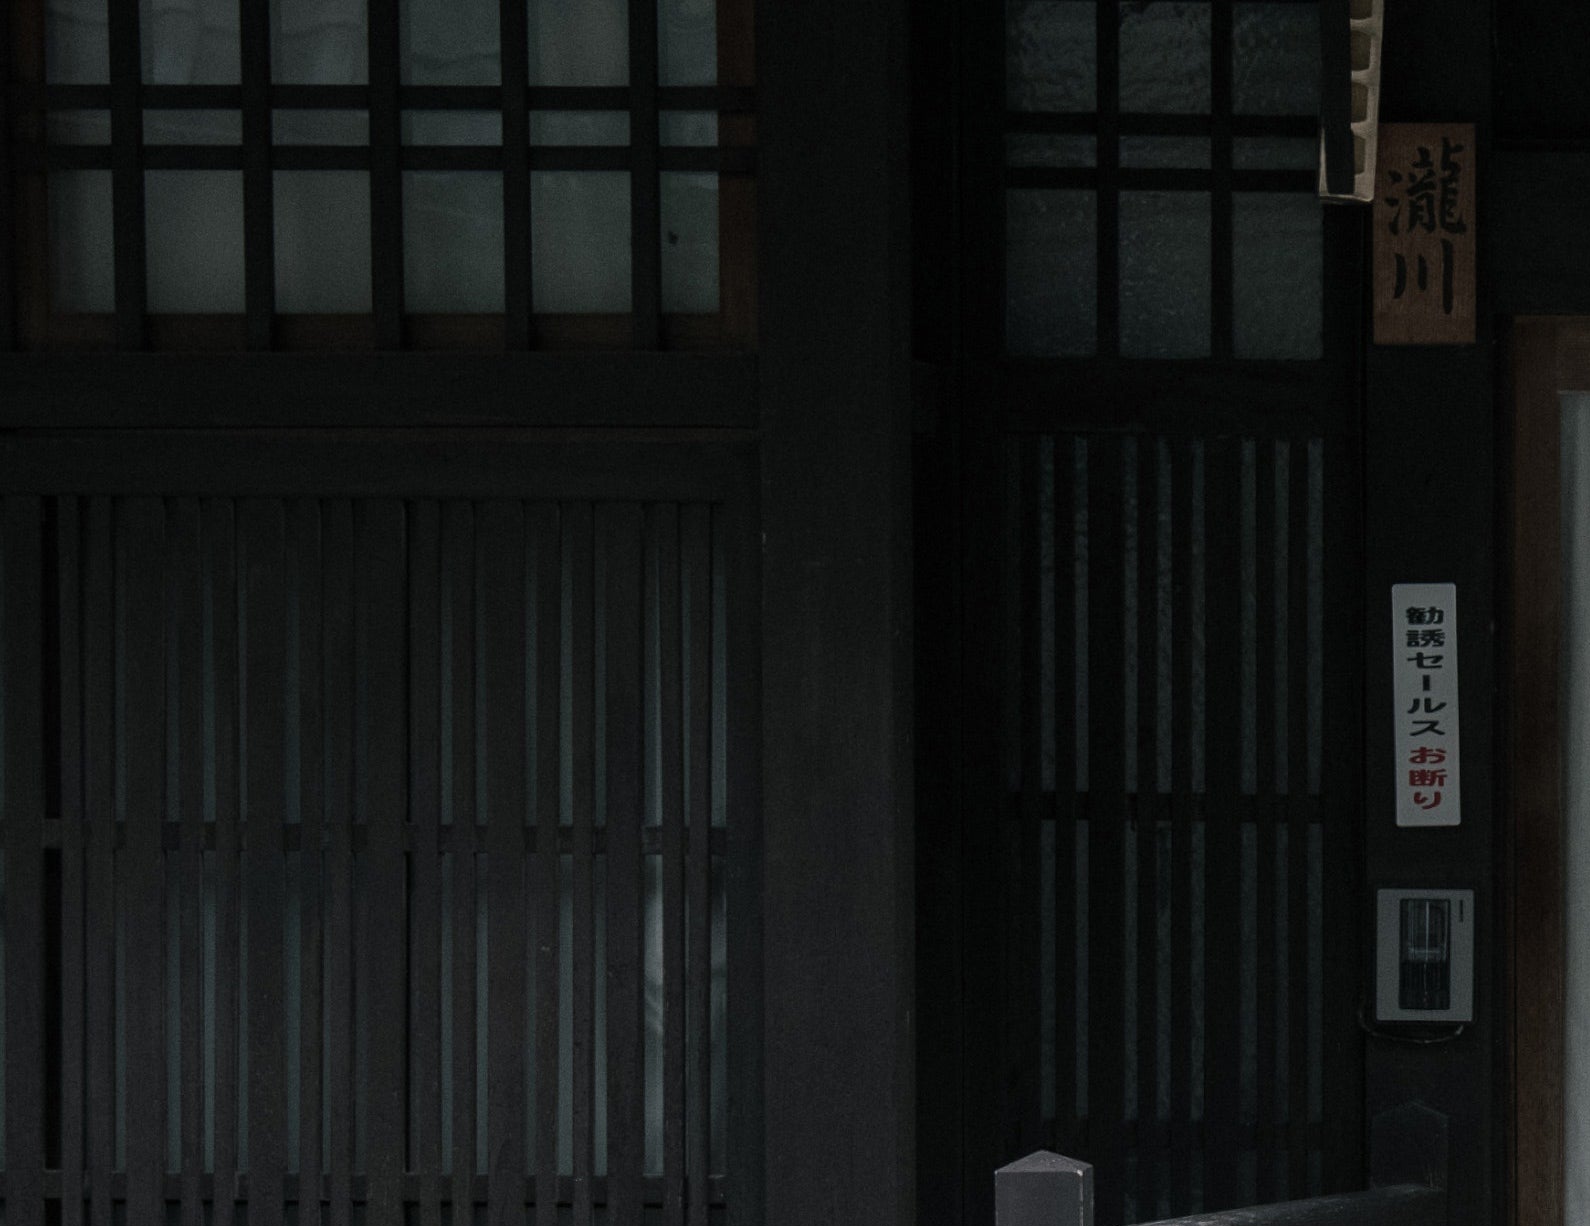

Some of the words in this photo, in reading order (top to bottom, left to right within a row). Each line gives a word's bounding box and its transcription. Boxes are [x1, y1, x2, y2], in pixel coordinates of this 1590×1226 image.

[1384, 136, 1467, 315] 瀧川
[1405, 606, 1448, 810] 勧誘セールスお断り
